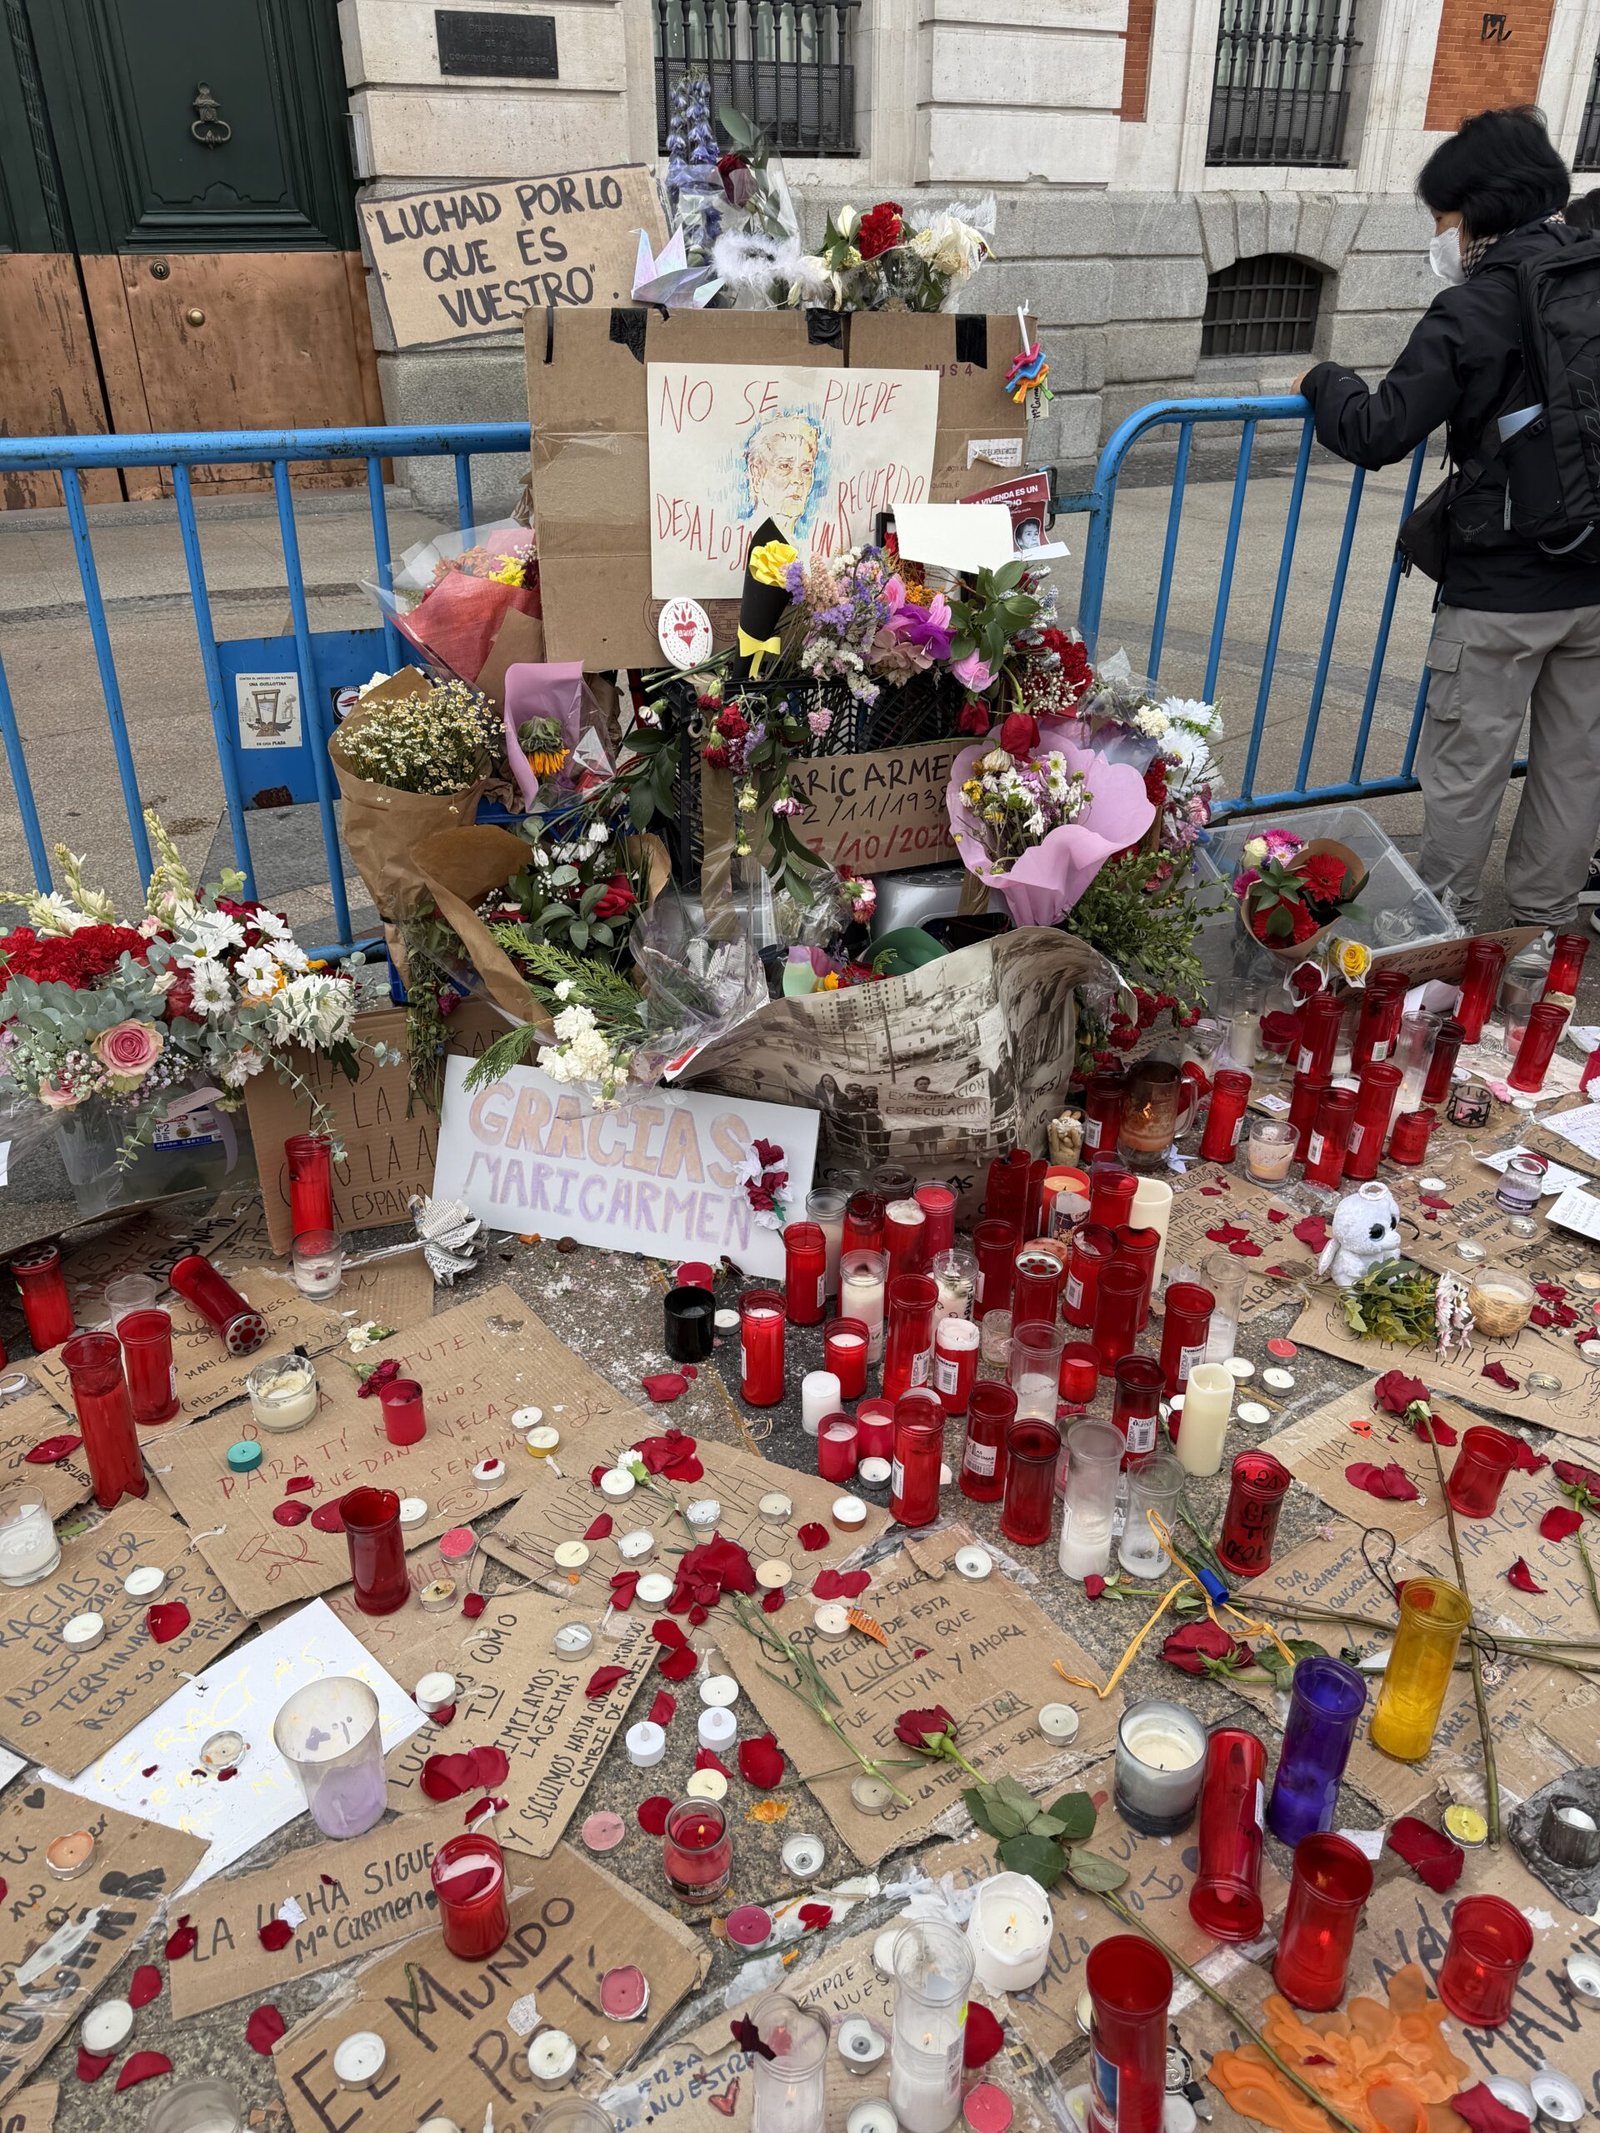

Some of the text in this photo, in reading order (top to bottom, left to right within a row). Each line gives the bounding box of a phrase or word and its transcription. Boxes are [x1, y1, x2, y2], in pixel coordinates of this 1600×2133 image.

[515, 177, 585, 221] POR
[585, 175, 623, 209] LO
[423, 226, 568, 283] QUE ES
[660, 375, 902, 434] NO SE PUEDE
[1014, 487, 1026, 497] ES
[1027, 484, 1039, 495] UN
[811, 517, 836, 559] UN
[469, 1081, 752, 1189] GRACIAS
[463, 1150, 752, 1251] MARICARMEN
[216, 1454, 308, 1499] PARA
[96, 1531, 156, 1572] POR
[469, 1613, 518, 1664] COMO
[881, 1614, 910, 1636] DE
[911, 1595, 951, 1623] ESTA
[841, 1608, 976, 1693] LUCHA QUE
[872, 1665, 945, 1705] TUYA
[946, 1653, 964, 1675] Y
[969, 1622, 1027, 1662] AHORA
[519, 1673, 580, 1759] LAGRIMAS
[569, 1633, 658, 1789] CAMBIE DE CAMINO
[503, 1827, 534, 1847] Y
[519, 1753, 577, 1829] SEGUIMOS
[563, 1709, 599, 1759] HASTA
[364, 1841, 436, 1896] SIGUE
[295, 1923, 328, 1964] Mª
[384, 1896, 575, 2053] MUNDO
